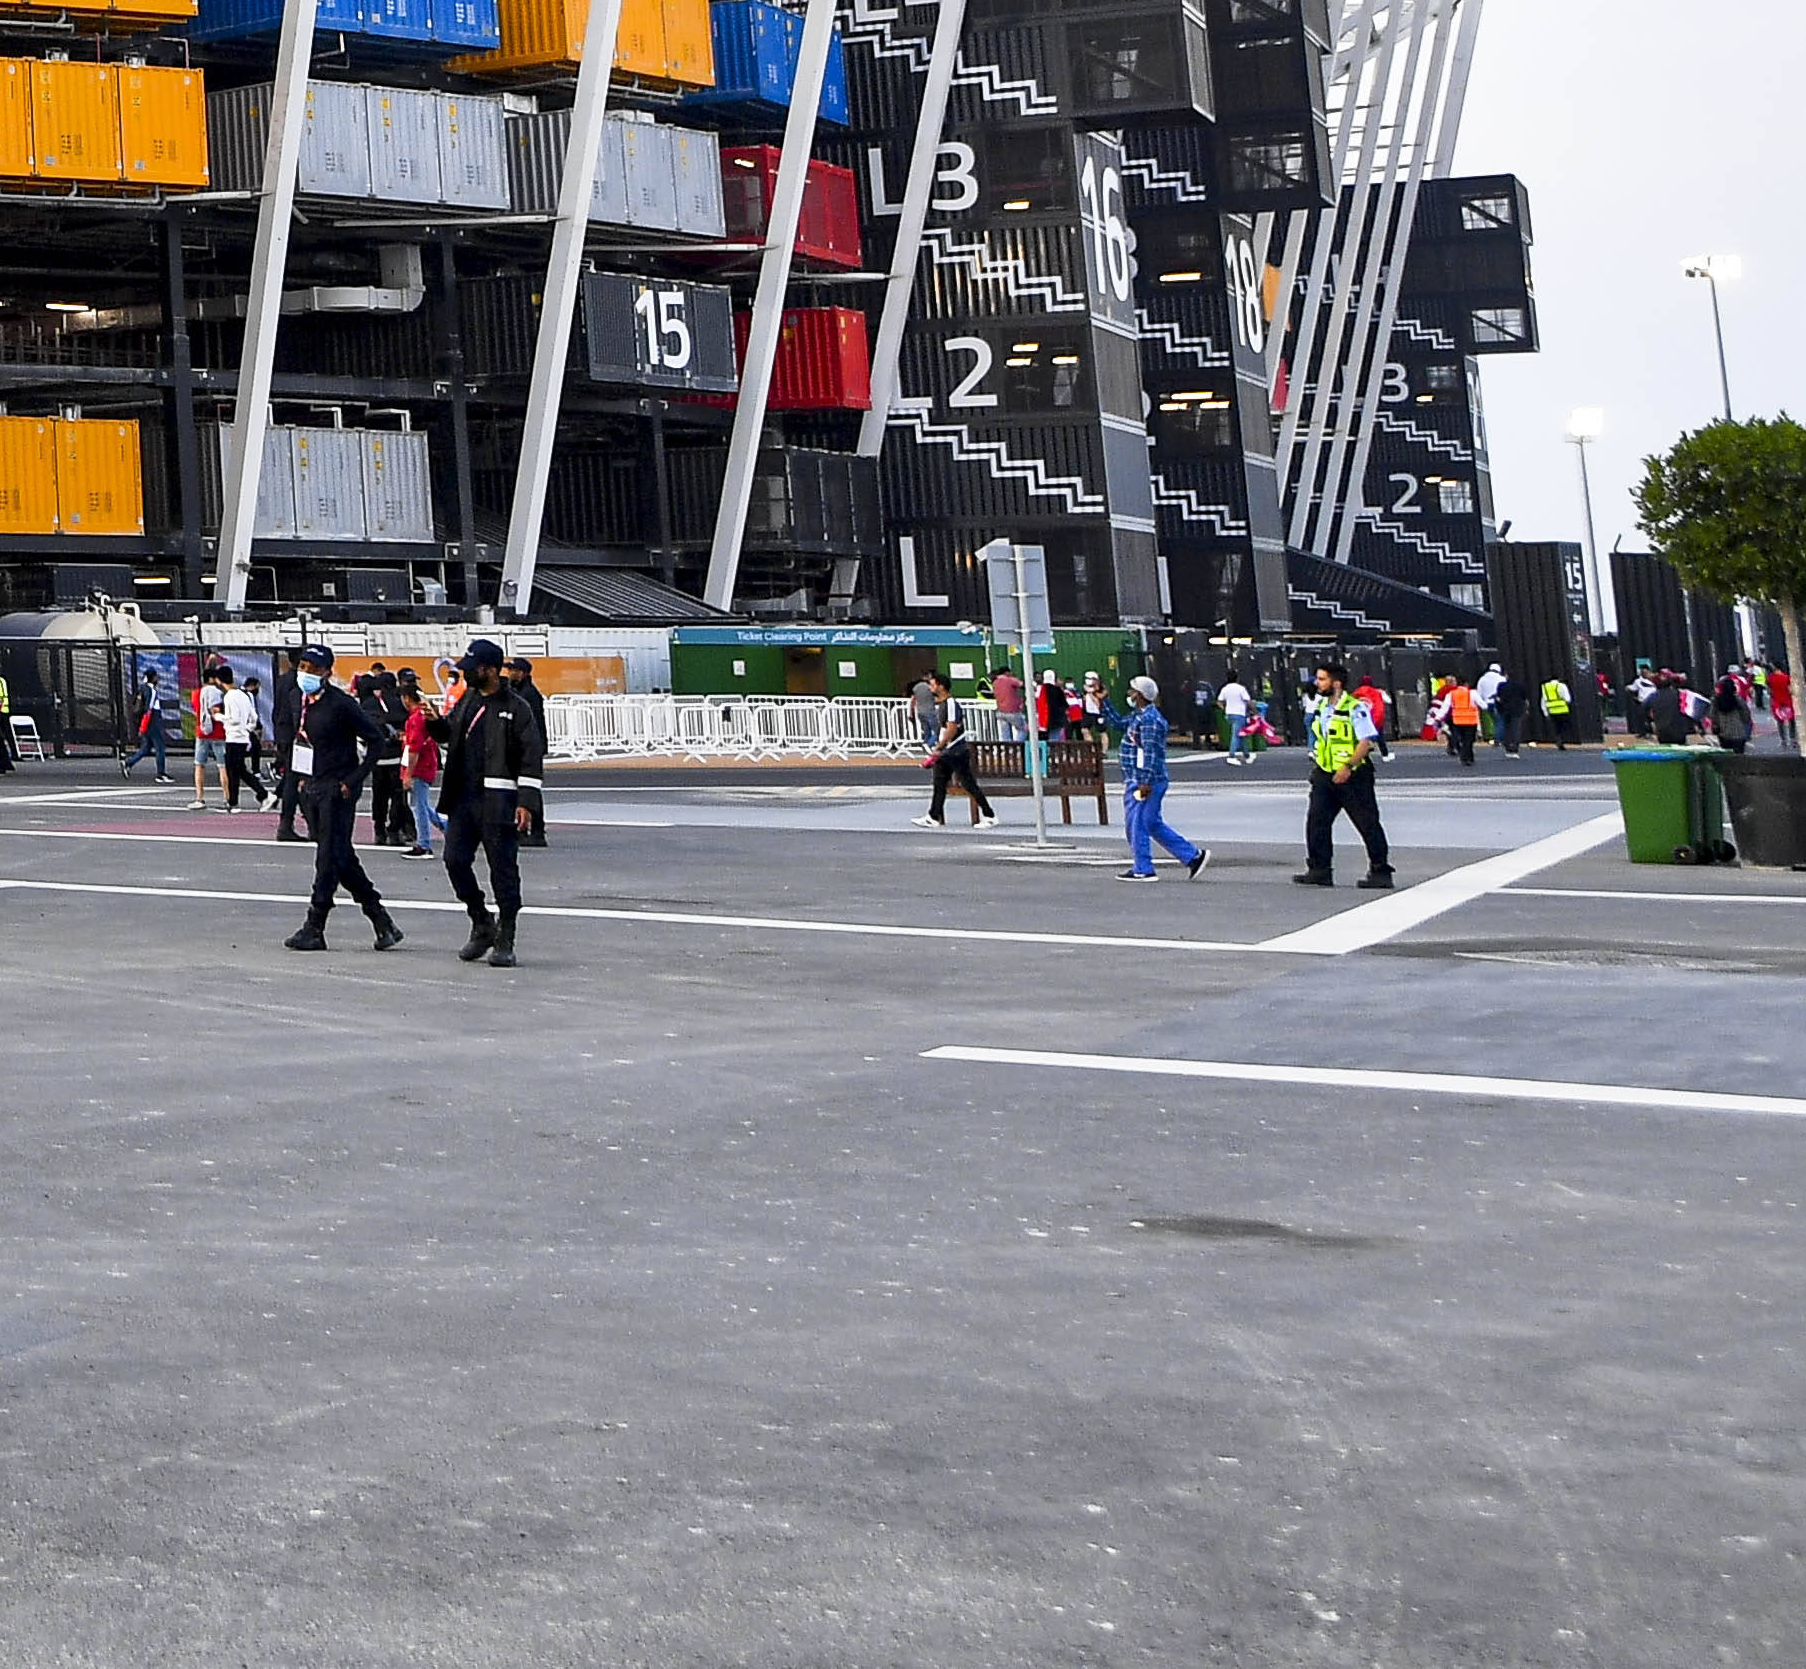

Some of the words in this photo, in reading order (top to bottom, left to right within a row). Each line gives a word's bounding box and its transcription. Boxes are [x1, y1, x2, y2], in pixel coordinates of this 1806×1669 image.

[868, 142, 978, 216] L3
[1082, 156, 1129, 302] 16
[635, 289, 691, 370] 15
[1225, 234, 1263, 353] 18
[1565, 562, 1583, 590] 15
[737, 631, 763, 641] Ticket
[764, 631, 802, 643] Clearing
[804, 631, 827, 641] Point
